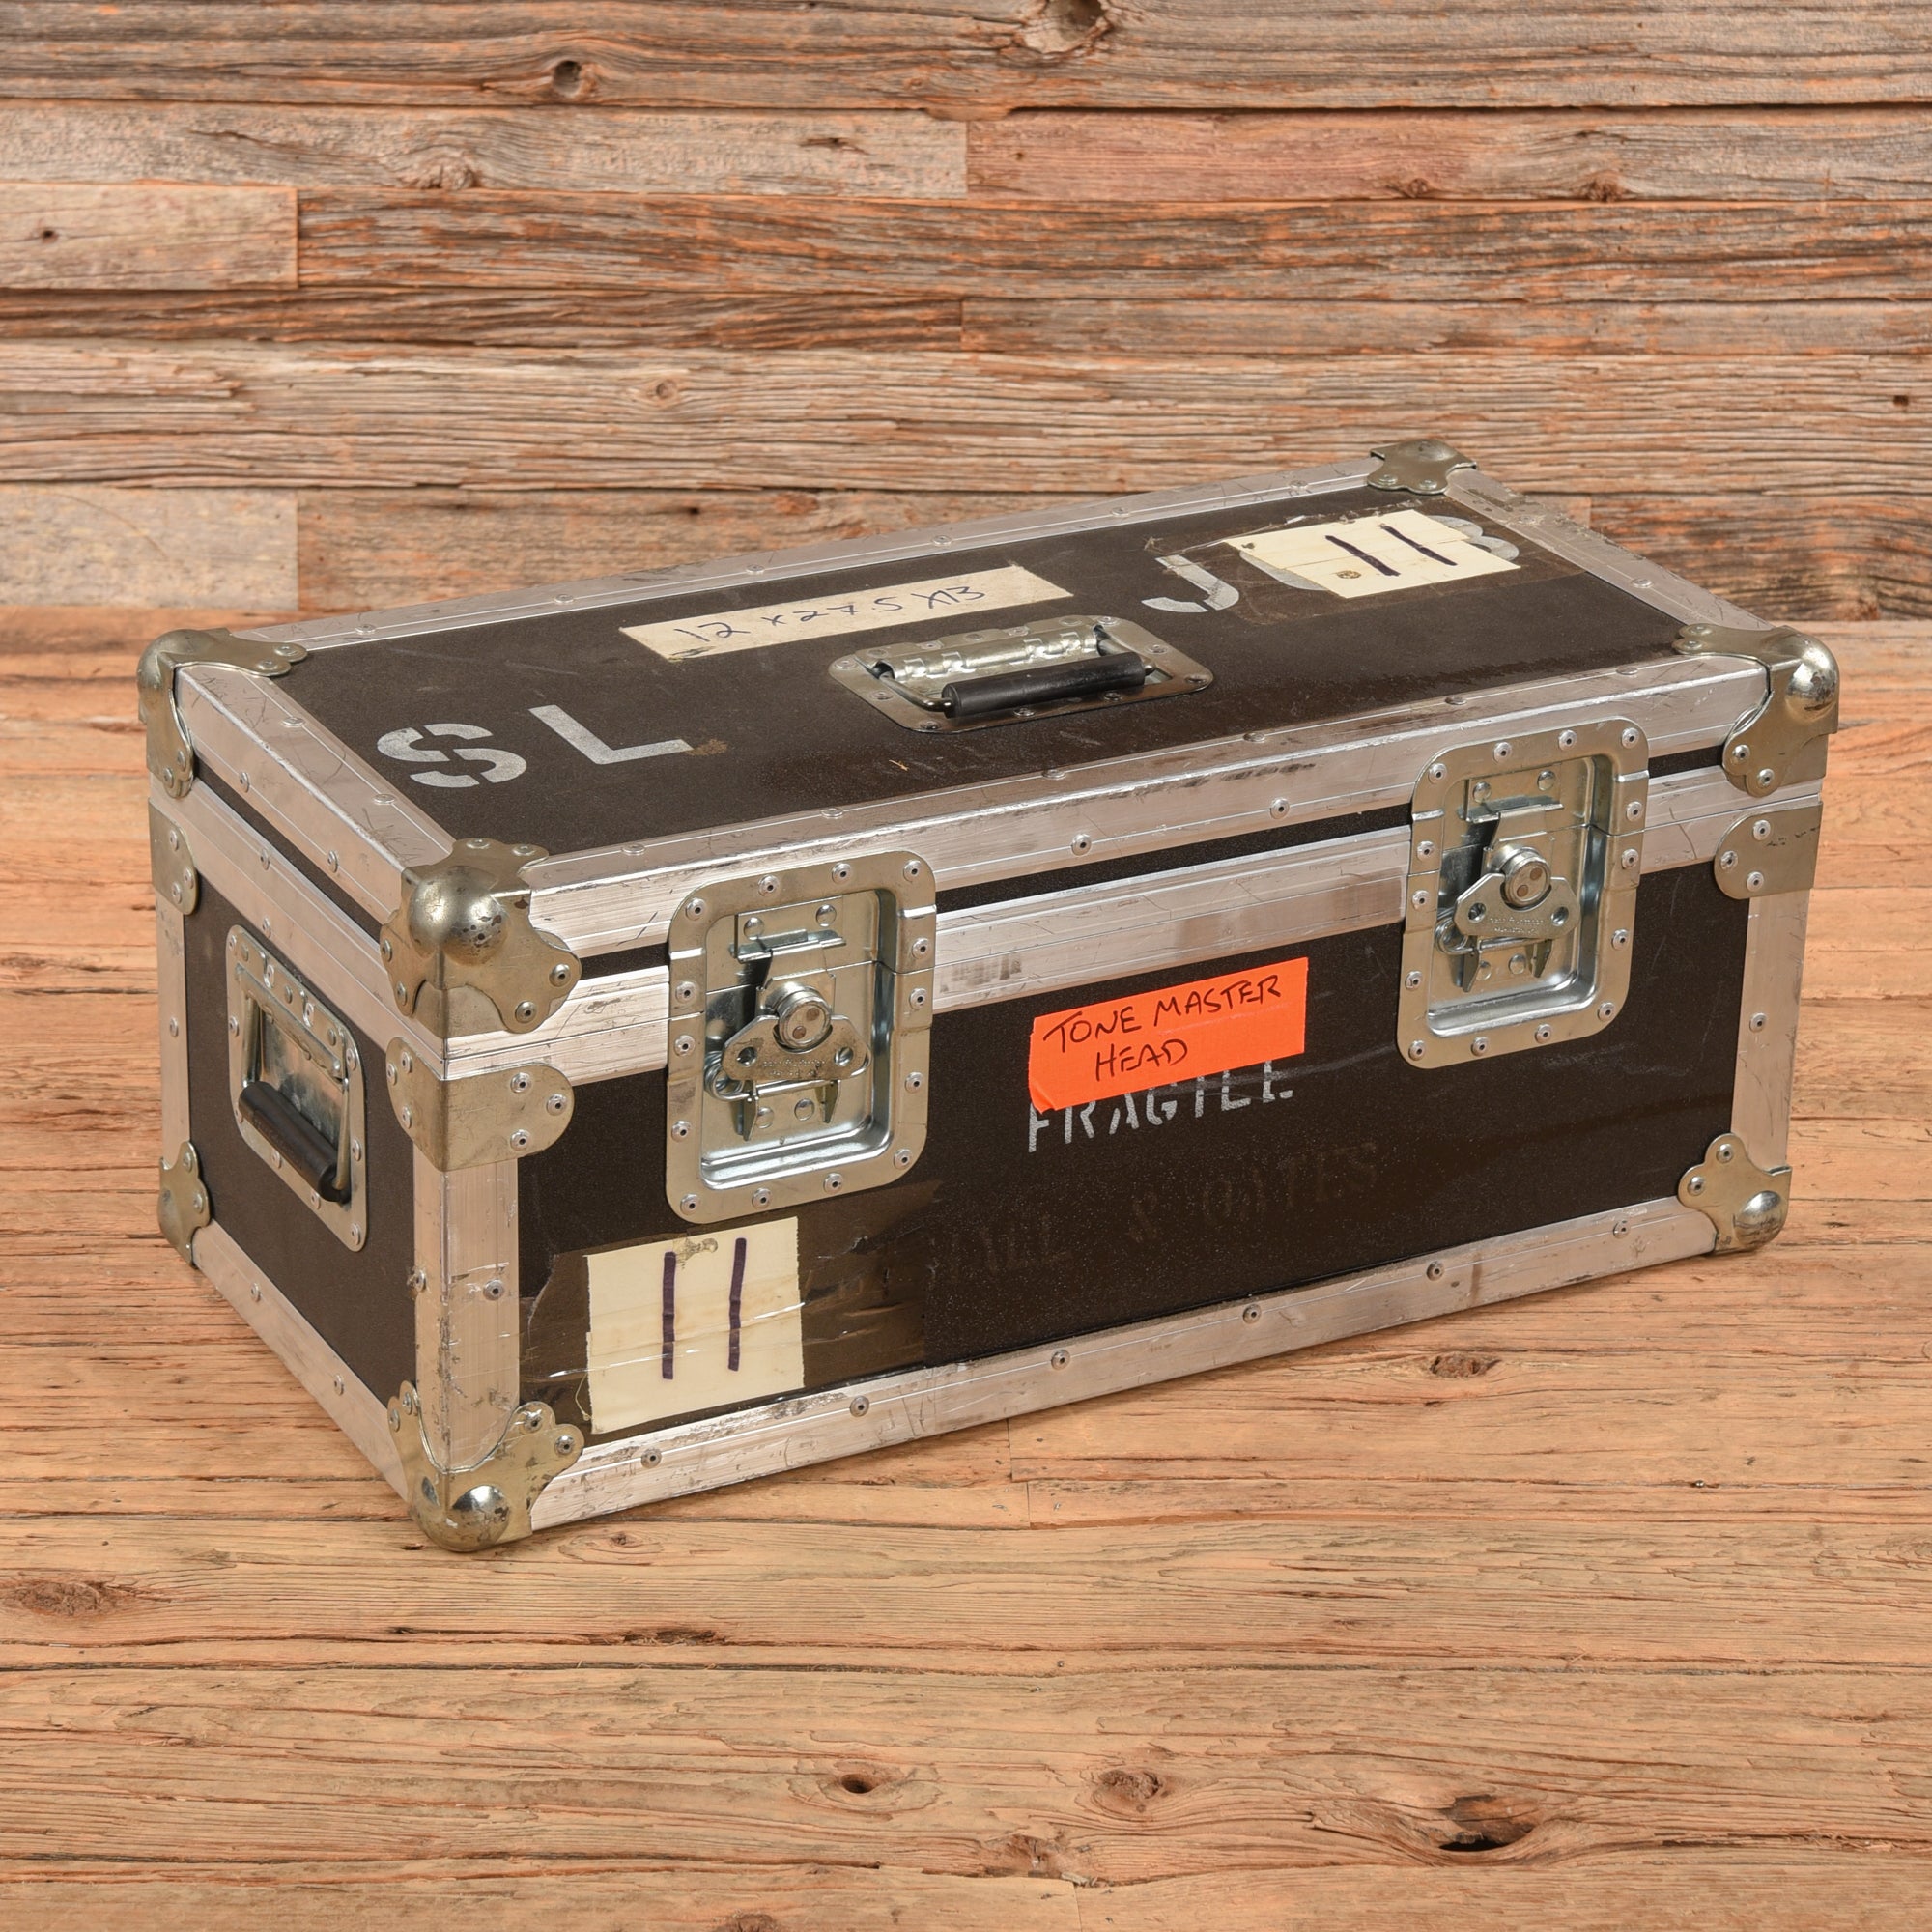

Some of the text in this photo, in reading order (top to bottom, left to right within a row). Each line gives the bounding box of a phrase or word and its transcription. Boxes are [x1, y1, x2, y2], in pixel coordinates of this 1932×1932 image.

[673, 621, 752, 643] 12
[1042, 974, 1282, 1053] TONE MASTER
[1095, 1038, 1189, 1082] HEAD
